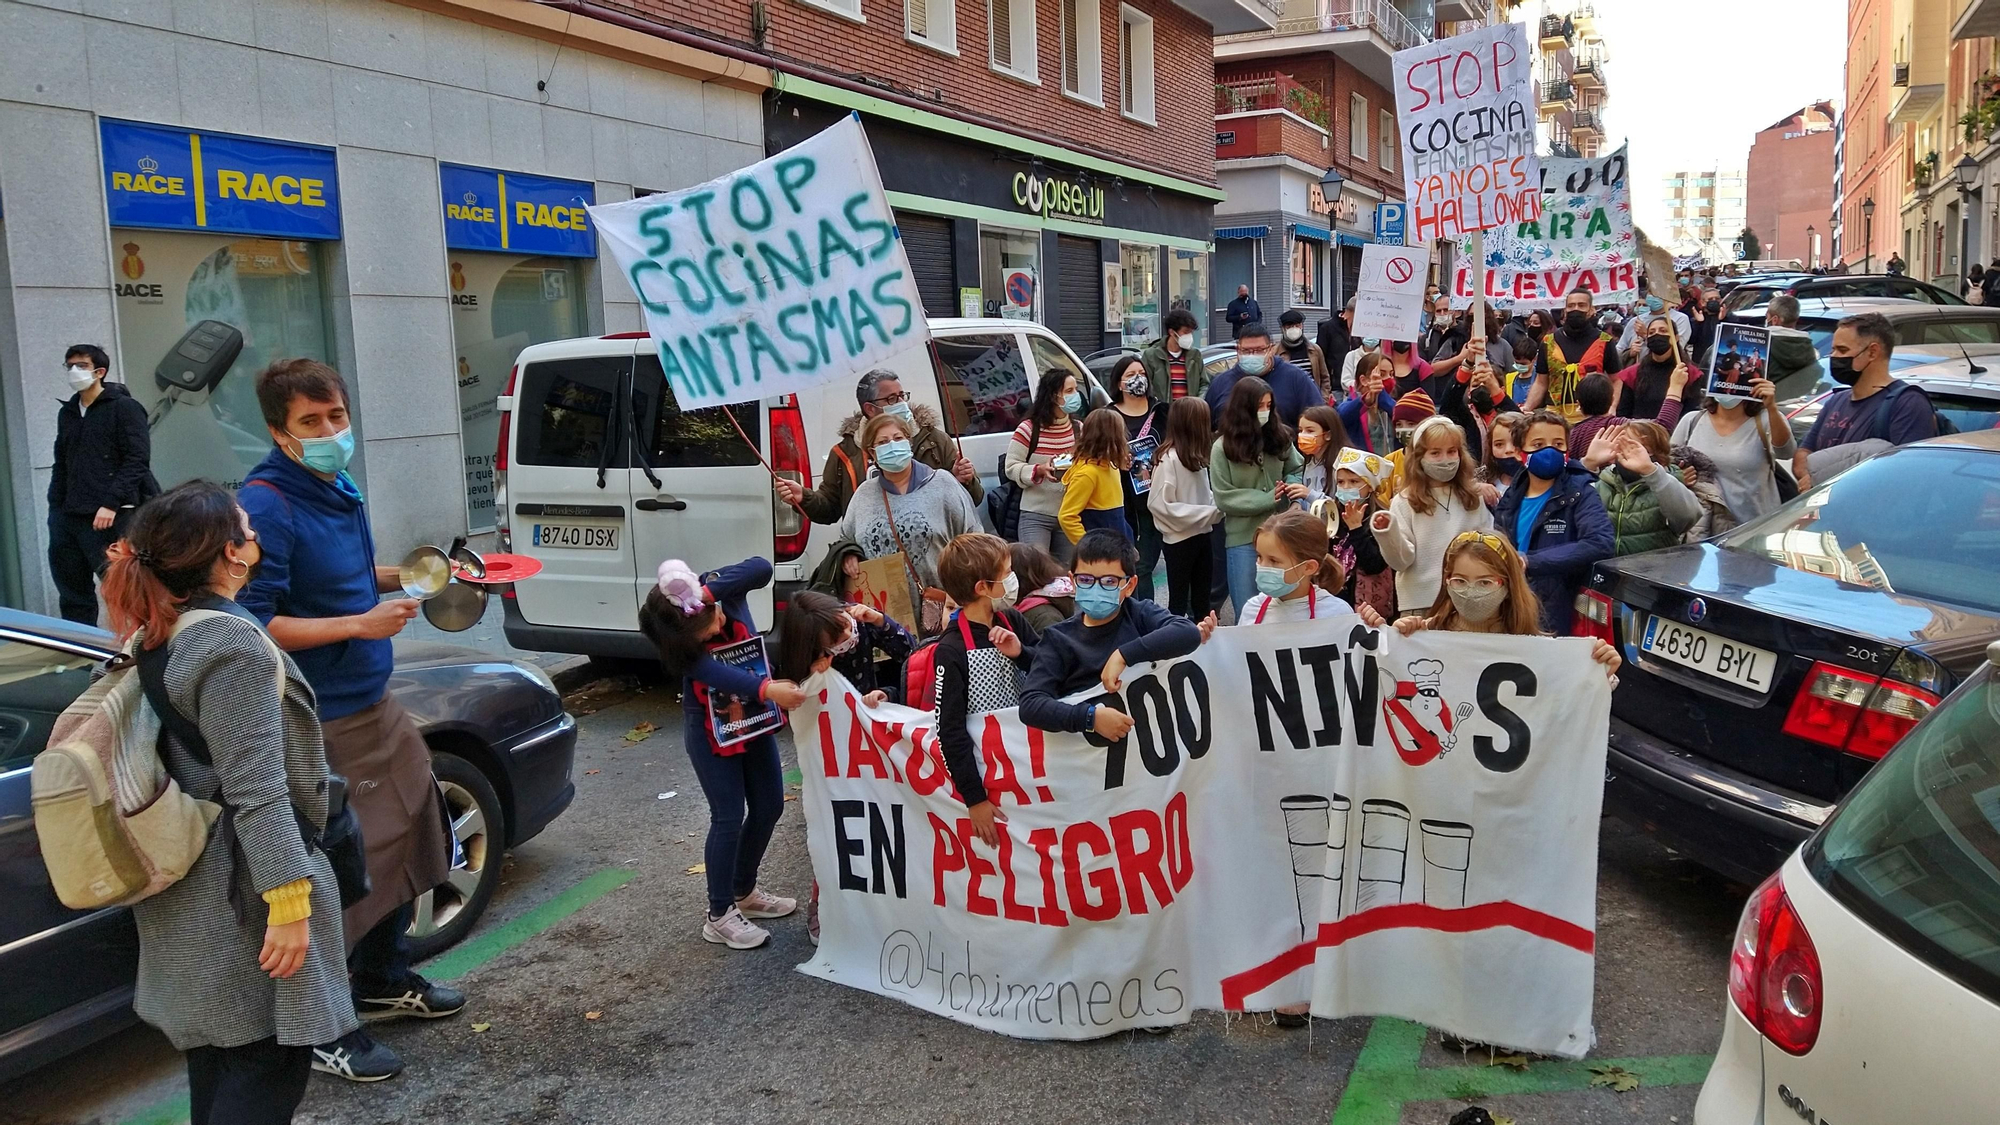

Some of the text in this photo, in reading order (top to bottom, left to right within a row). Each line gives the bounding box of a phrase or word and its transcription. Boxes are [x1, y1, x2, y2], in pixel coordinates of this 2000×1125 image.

[1407, 41, 1517, 112] STOP
[1410, 101, 1526, 153] COCINA
[1413, 130, 1535, 178] FANTASMA
[112, 171, 185, 196] RACE
[217, 169, 325, 207] RACE
[1540, 155, 1625, 194] LUD
[447, 203, 495, 223] RACE
[516, 201, 587, 231] RACE
[638, 156, 817, 258] STOP
[1381, 205, 1402, 231] P
[1415, 188, 1542, 242] HALLOWEN
[1517, 207, 1612, 240] ARA
[629, 192, 895, 315] COCINAS
[452, 295, 478, 306] ACE
[1456, 263, 1635, 299] LLEVAR
[660, 271, 913, 399] ANTASMAS
[543, 505, 592, 516] Mercedes-Benz
[542, 526, 580, 546] 8740
[584, 528, 614, 547] DSX
[1655, 623, 1707, 664] 4630
[1716, 643, 1760, 686] BYL
[831, 791, 1194, 927] EN PELIGRO
[880, 930, 1184, 1027] @4chimeneas
